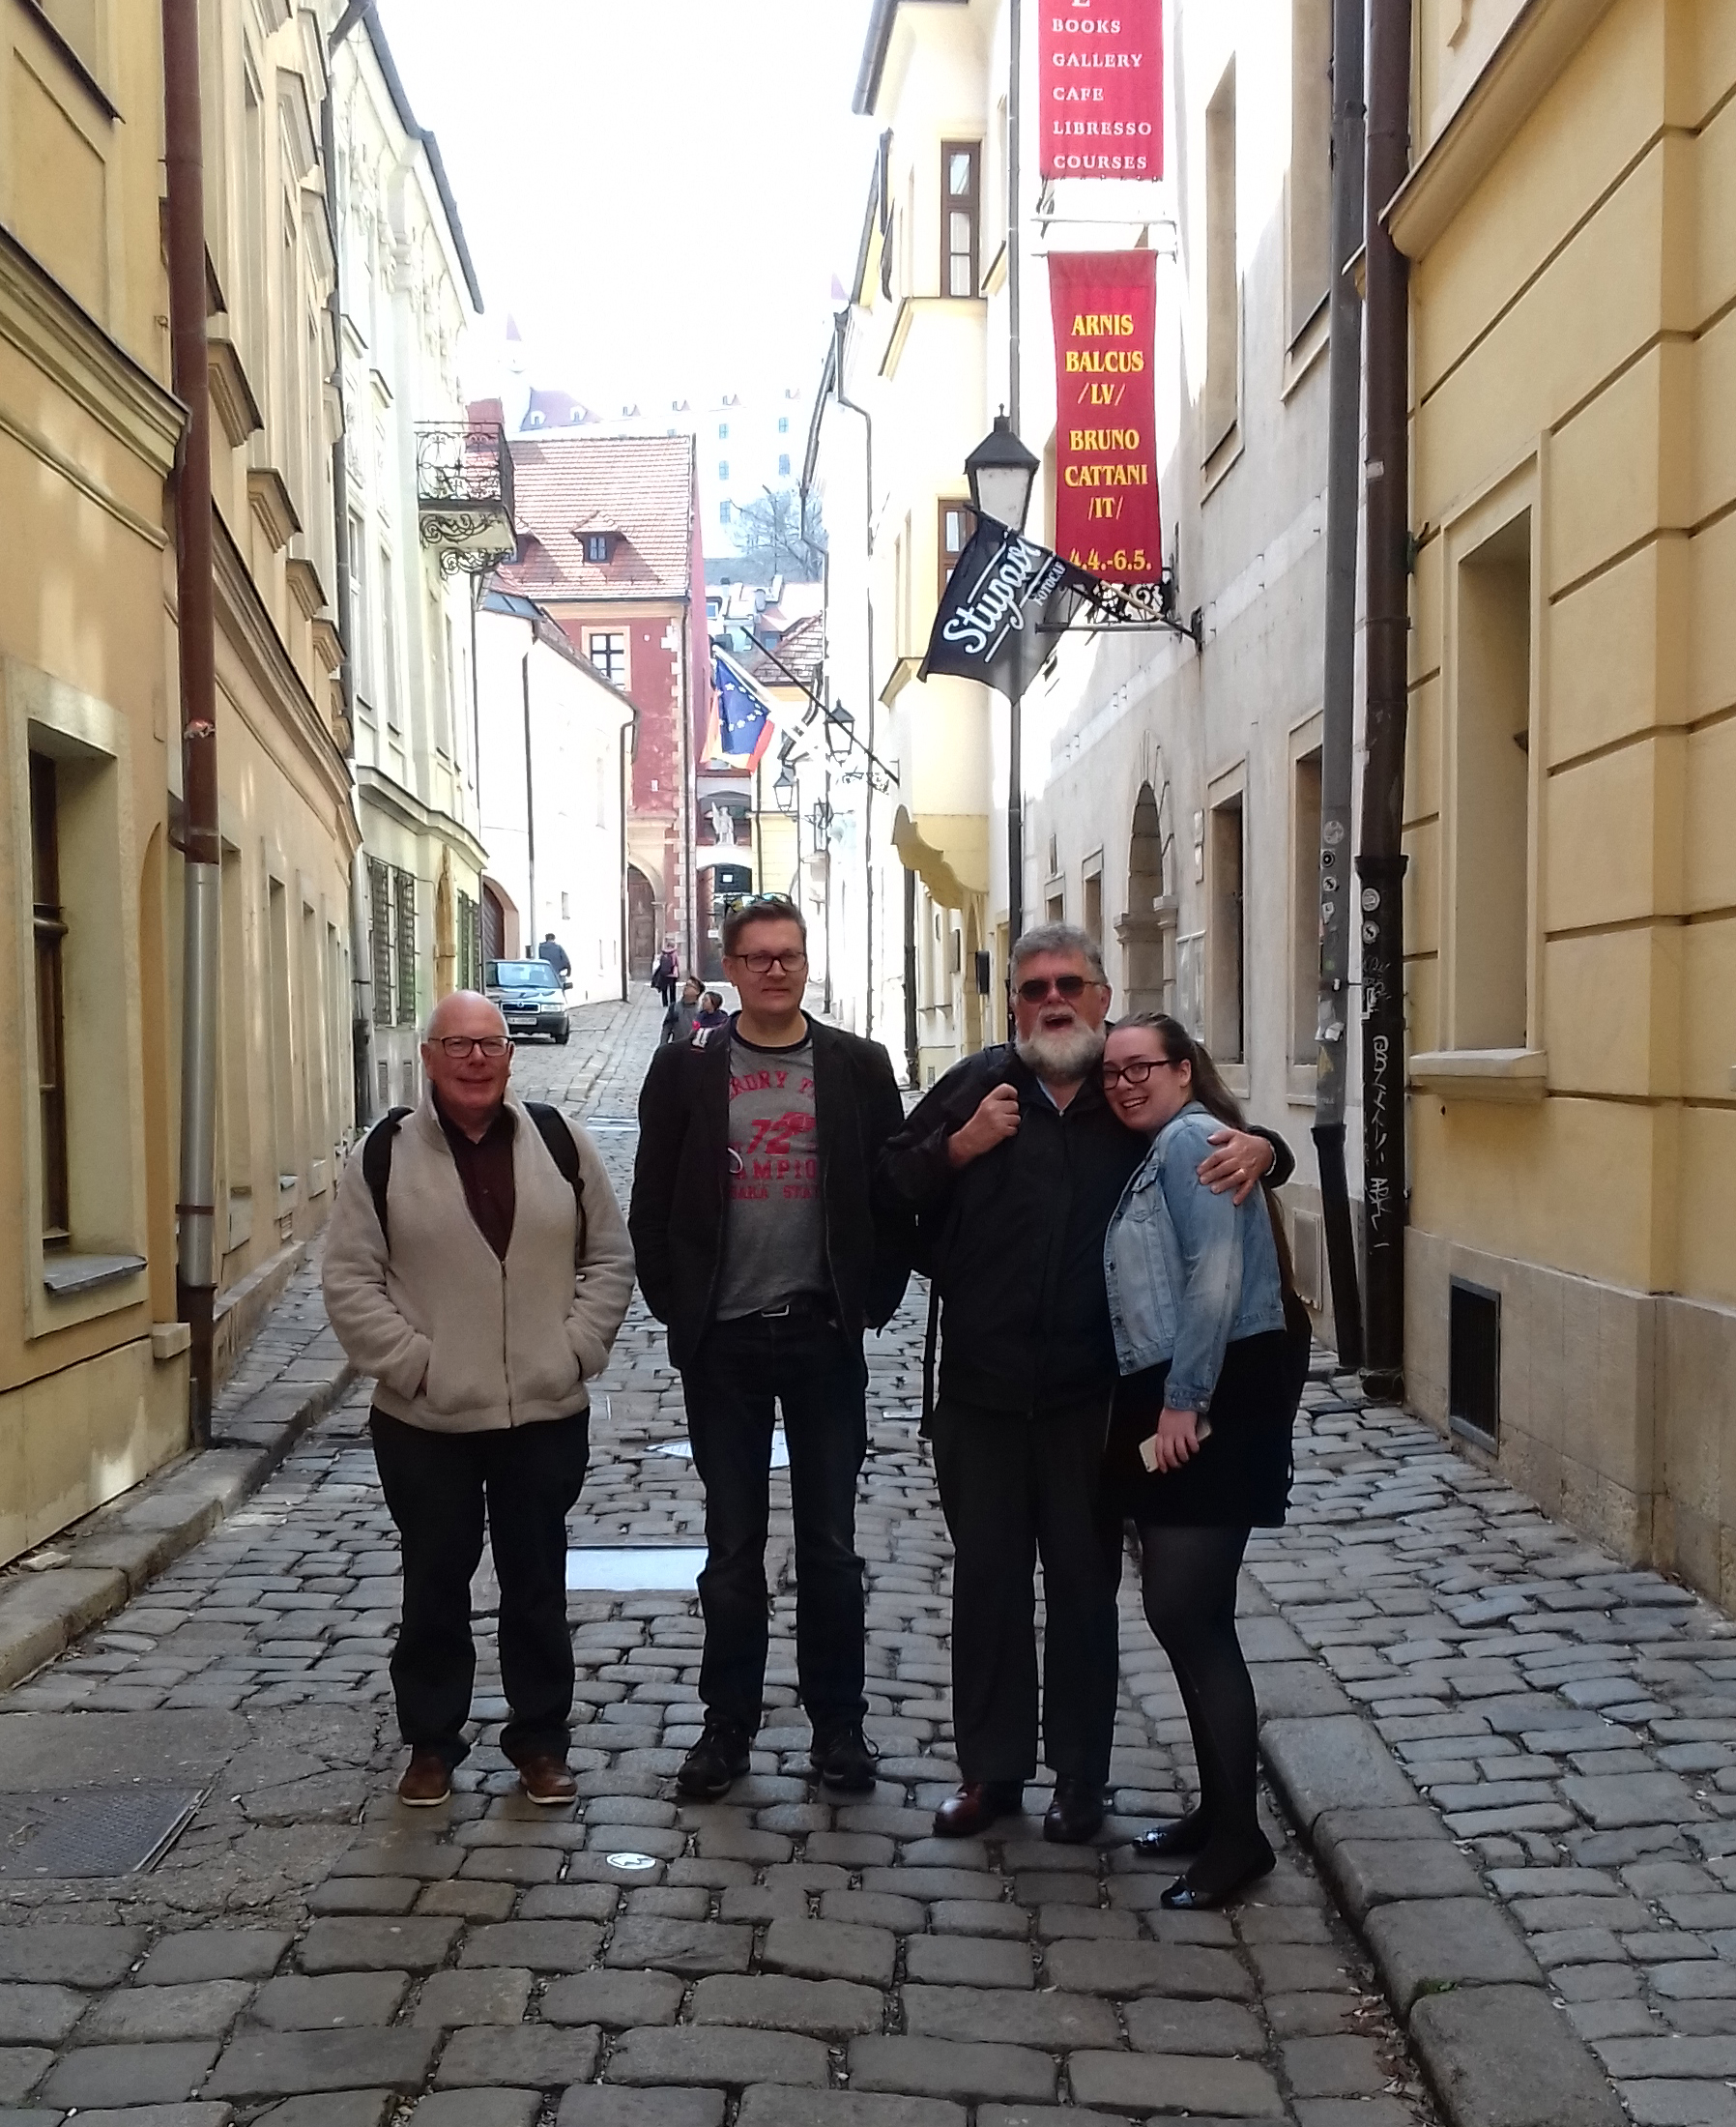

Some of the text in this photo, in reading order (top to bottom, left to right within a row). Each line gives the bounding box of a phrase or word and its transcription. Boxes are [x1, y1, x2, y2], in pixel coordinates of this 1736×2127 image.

[1052, 17, 1121, 34] BOOKS
[1052, 52, 1143, 68] GALLERY
[1053, 87, 1104, 102] CAFE
[1053, 121, 1152, 135] LIBRESSO
[1054, 155, 1147, 169] COURSES
[1071, 314, 1135, 336] ARNIS
[1064, 351, 1144, 373] BALCUS
[1077, 383, 1126, 406] /LV/
[1069, 429, 1140, 451] BRUNO
[1064, 464, 1148, 487] CATTANI
[1087, 496, 1124, 521] /IT/
